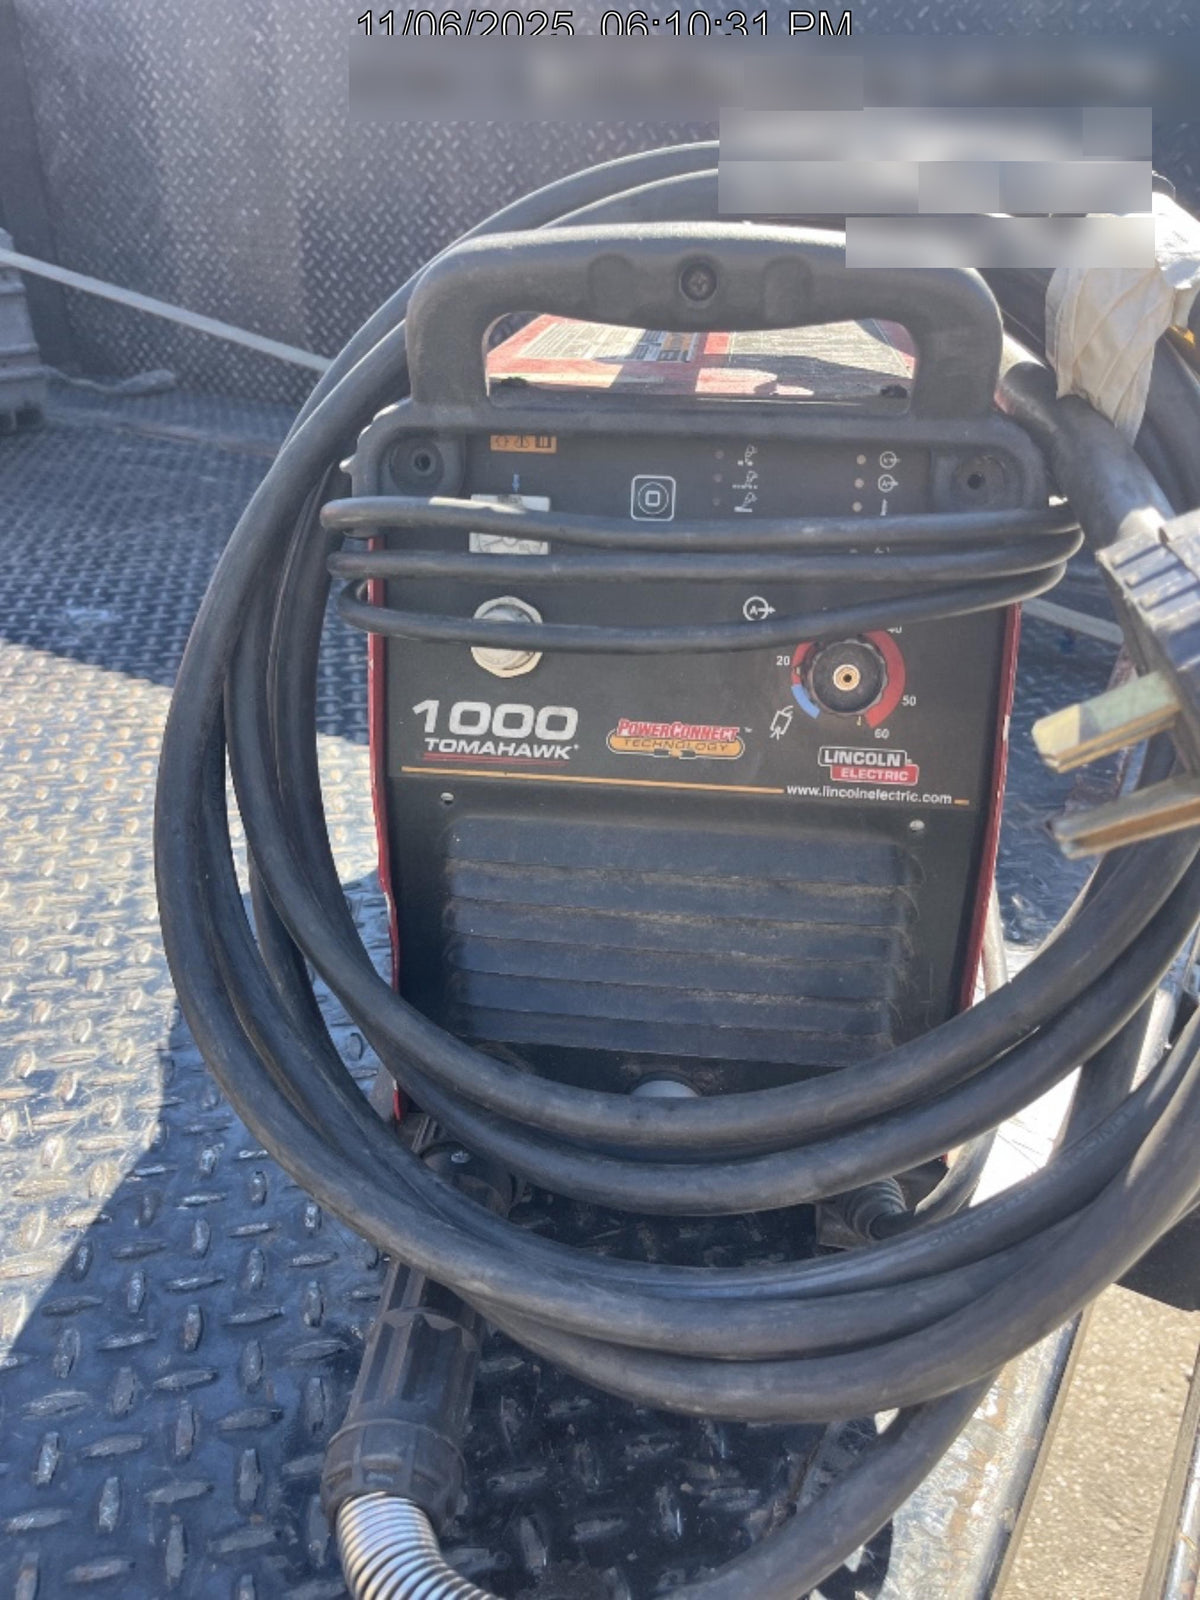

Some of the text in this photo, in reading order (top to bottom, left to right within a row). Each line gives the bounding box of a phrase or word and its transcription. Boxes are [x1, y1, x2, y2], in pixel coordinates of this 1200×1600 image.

[776, 655, 790, 666] 20
[902, 696, 917, 707] 50
[412, 699, 579, 741] 1000
[874, 728, 890, 739] 60
[623, 739, 729, 752] TECHNOLOGY
[823, 749, 901, 767] LINCOLN
[840, 767, 910, 782] ELECTRIC
[786, 784, 953, 805] www.lincolnelectric.com
